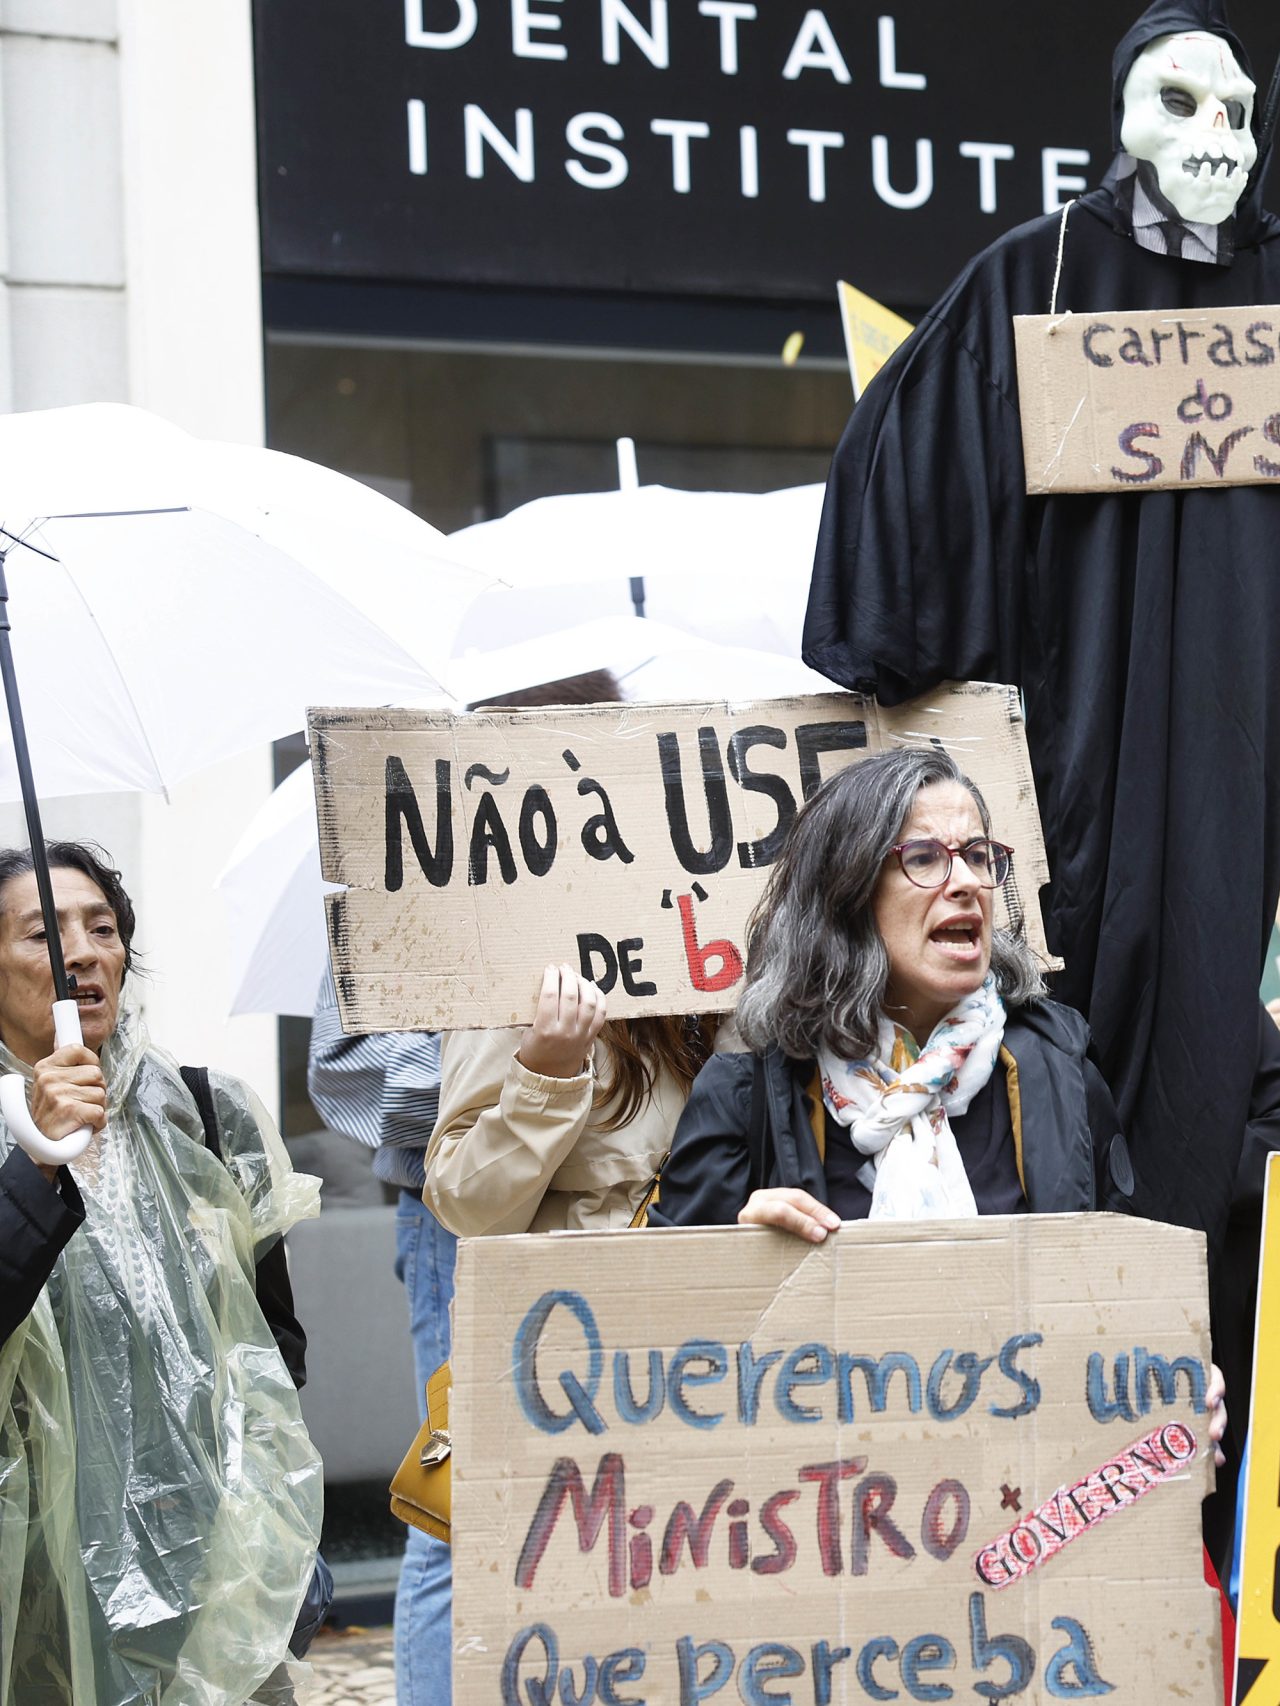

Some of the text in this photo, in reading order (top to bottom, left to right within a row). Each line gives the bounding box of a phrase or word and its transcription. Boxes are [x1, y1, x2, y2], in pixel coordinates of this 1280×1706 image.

[405, 0, 926, 90] DENTAL
[407, 99, 1091, 215] INSTITUTE
[1177, 378, 1233, 423] do
[576, 932, 658, 996] DE
[513, 1290, 1206, 1436] Queremos um
[975, 1422, 1196, 1586] GOVERNO
[501, 1592, 1118, 1706] Que perceba
